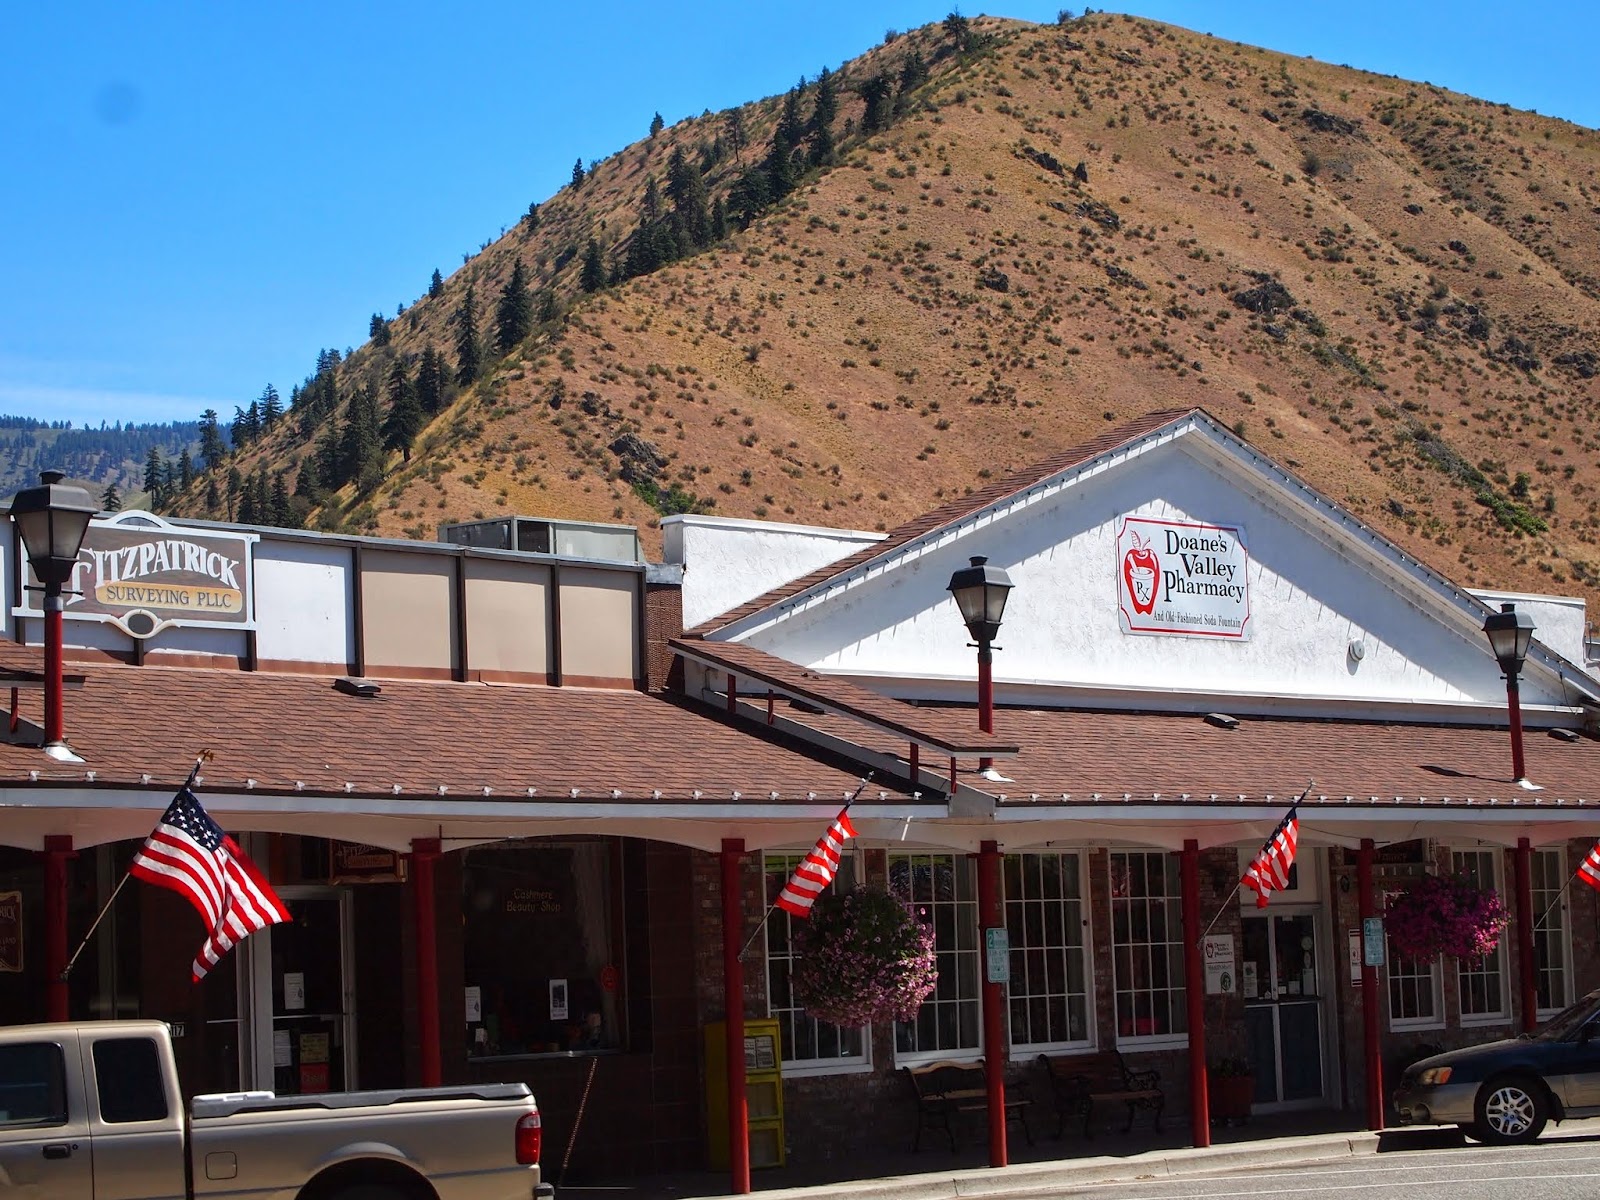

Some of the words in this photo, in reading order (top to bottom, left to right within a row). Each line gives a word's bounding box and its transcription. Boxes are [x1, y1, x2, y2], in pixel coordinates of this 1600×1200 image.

[1164, 529, 1227, 555] Doane's
[67, 540, 240, 605] FITZPATRICK
[1179, 553, 1236, 582] Valley
[106, 585, 190, 605] SURVEYING
[197, 591, 232, 608] PLLC
[1163, 570, 1245, 603] Pharmacy
[1153, 610, 1164, 622] And
[1203, 614, 1217, 626] Soda
[1218, 615, 1241, 628] Fountain
[506, 900, 536, 912] Beauty
[541, 900, 561, 912] Shop
